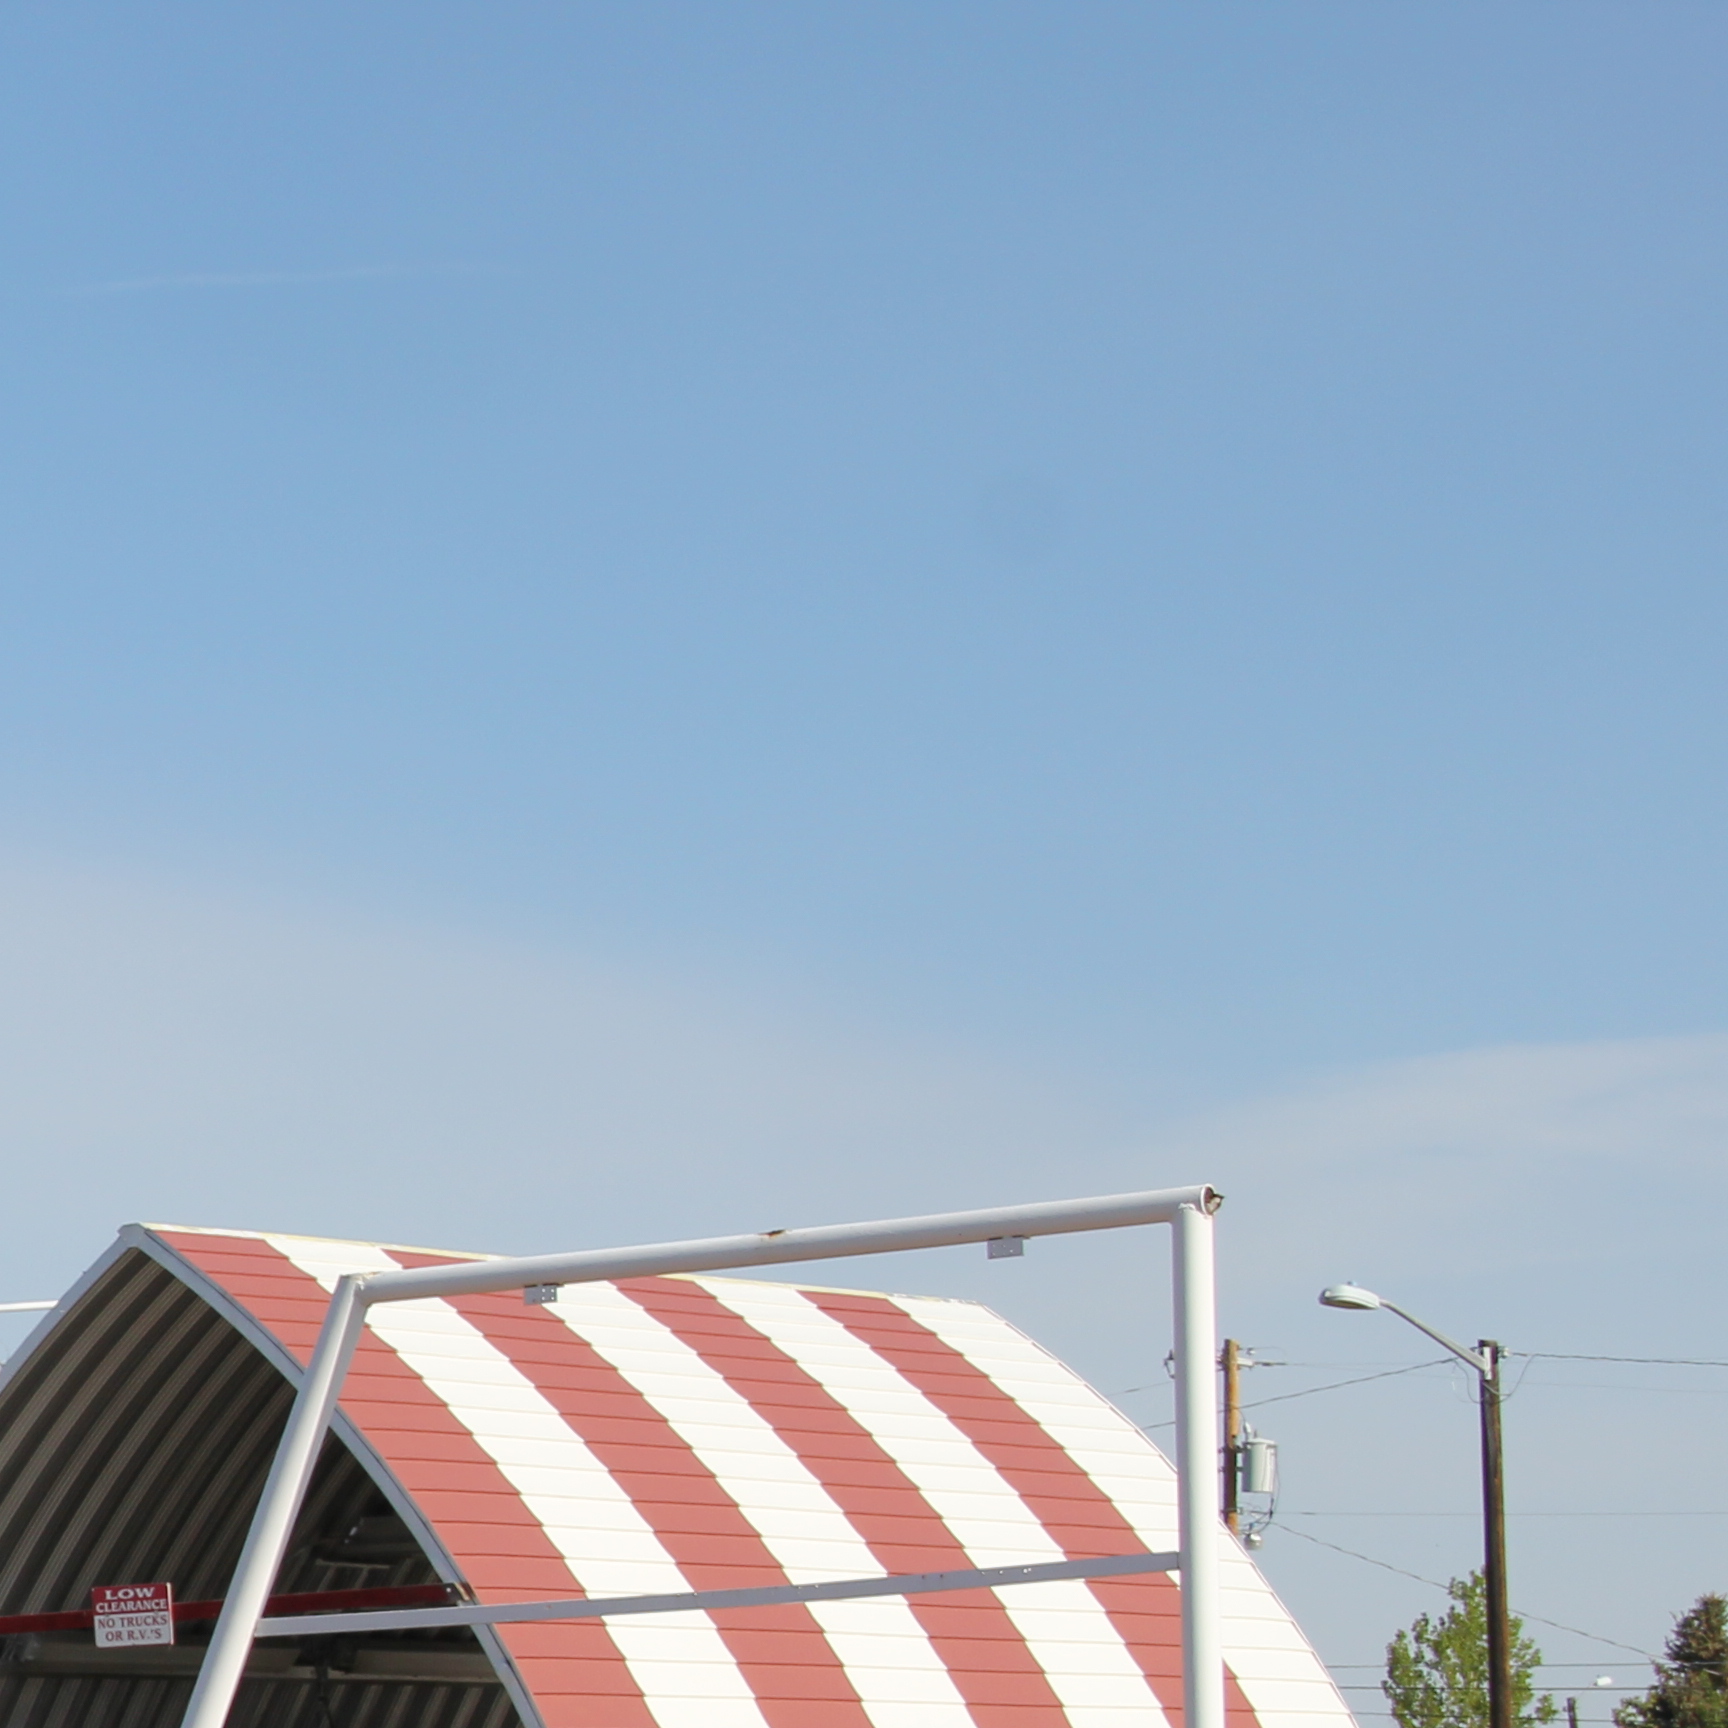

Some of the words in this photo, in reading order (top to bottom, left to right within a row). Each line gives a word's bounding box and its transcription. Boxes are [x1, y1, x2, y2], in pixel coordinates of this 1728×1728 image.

[105, 1587, 155, 1600] LOW
[95, 1599, 167, 1613] CLEARANCE
[97, 1618, 115, 1629] NO
[120, 1615, 168, 1627] TRUCKS
[105, 1631, 123, 1641] OR
